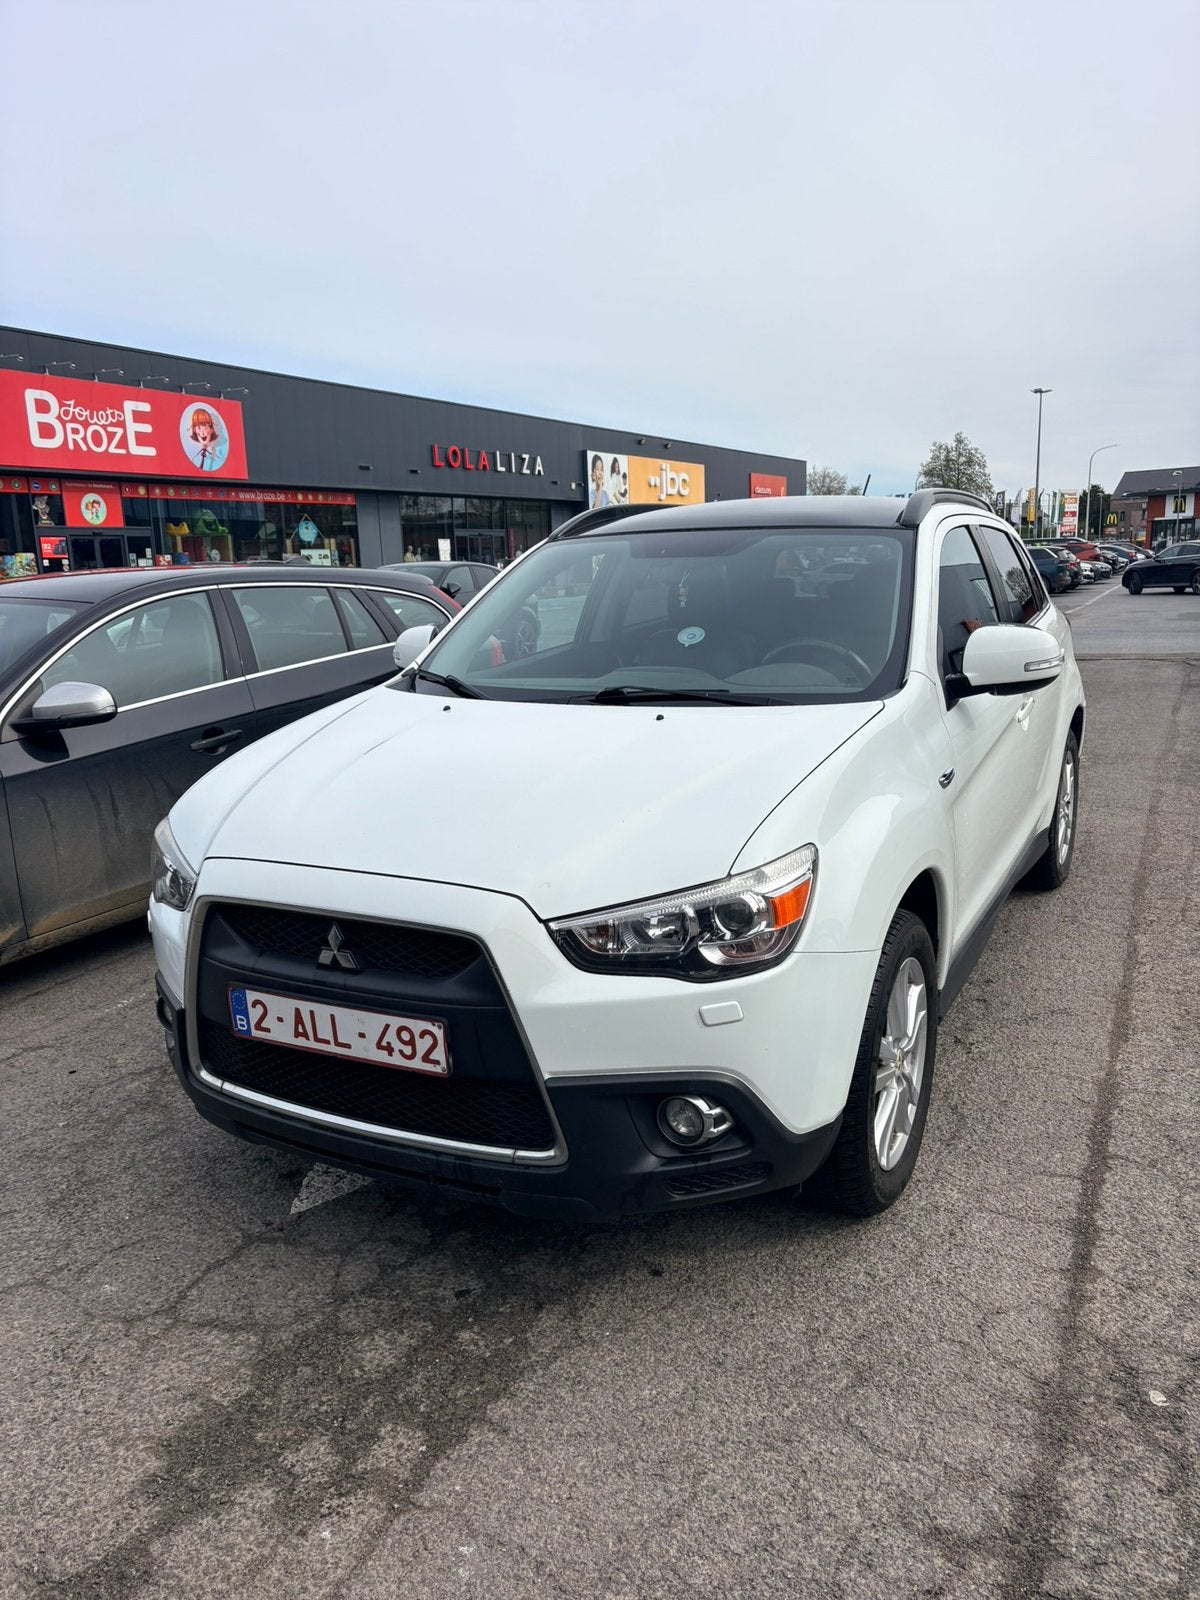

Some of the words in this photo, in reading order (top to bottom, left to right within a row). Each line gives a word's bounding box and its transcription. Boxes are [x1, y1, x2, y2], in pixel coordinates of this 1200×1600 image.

[24, 388, 157, 457] BROZE
[60, 399, 125, 425] Jouets
[238, 490, 286, 501] www.broze.be
[658, 463, 690, 501] jbc
[236, 1015, 248, 1031] B
[251, 999, 441, 1066] 2-ALL-492
